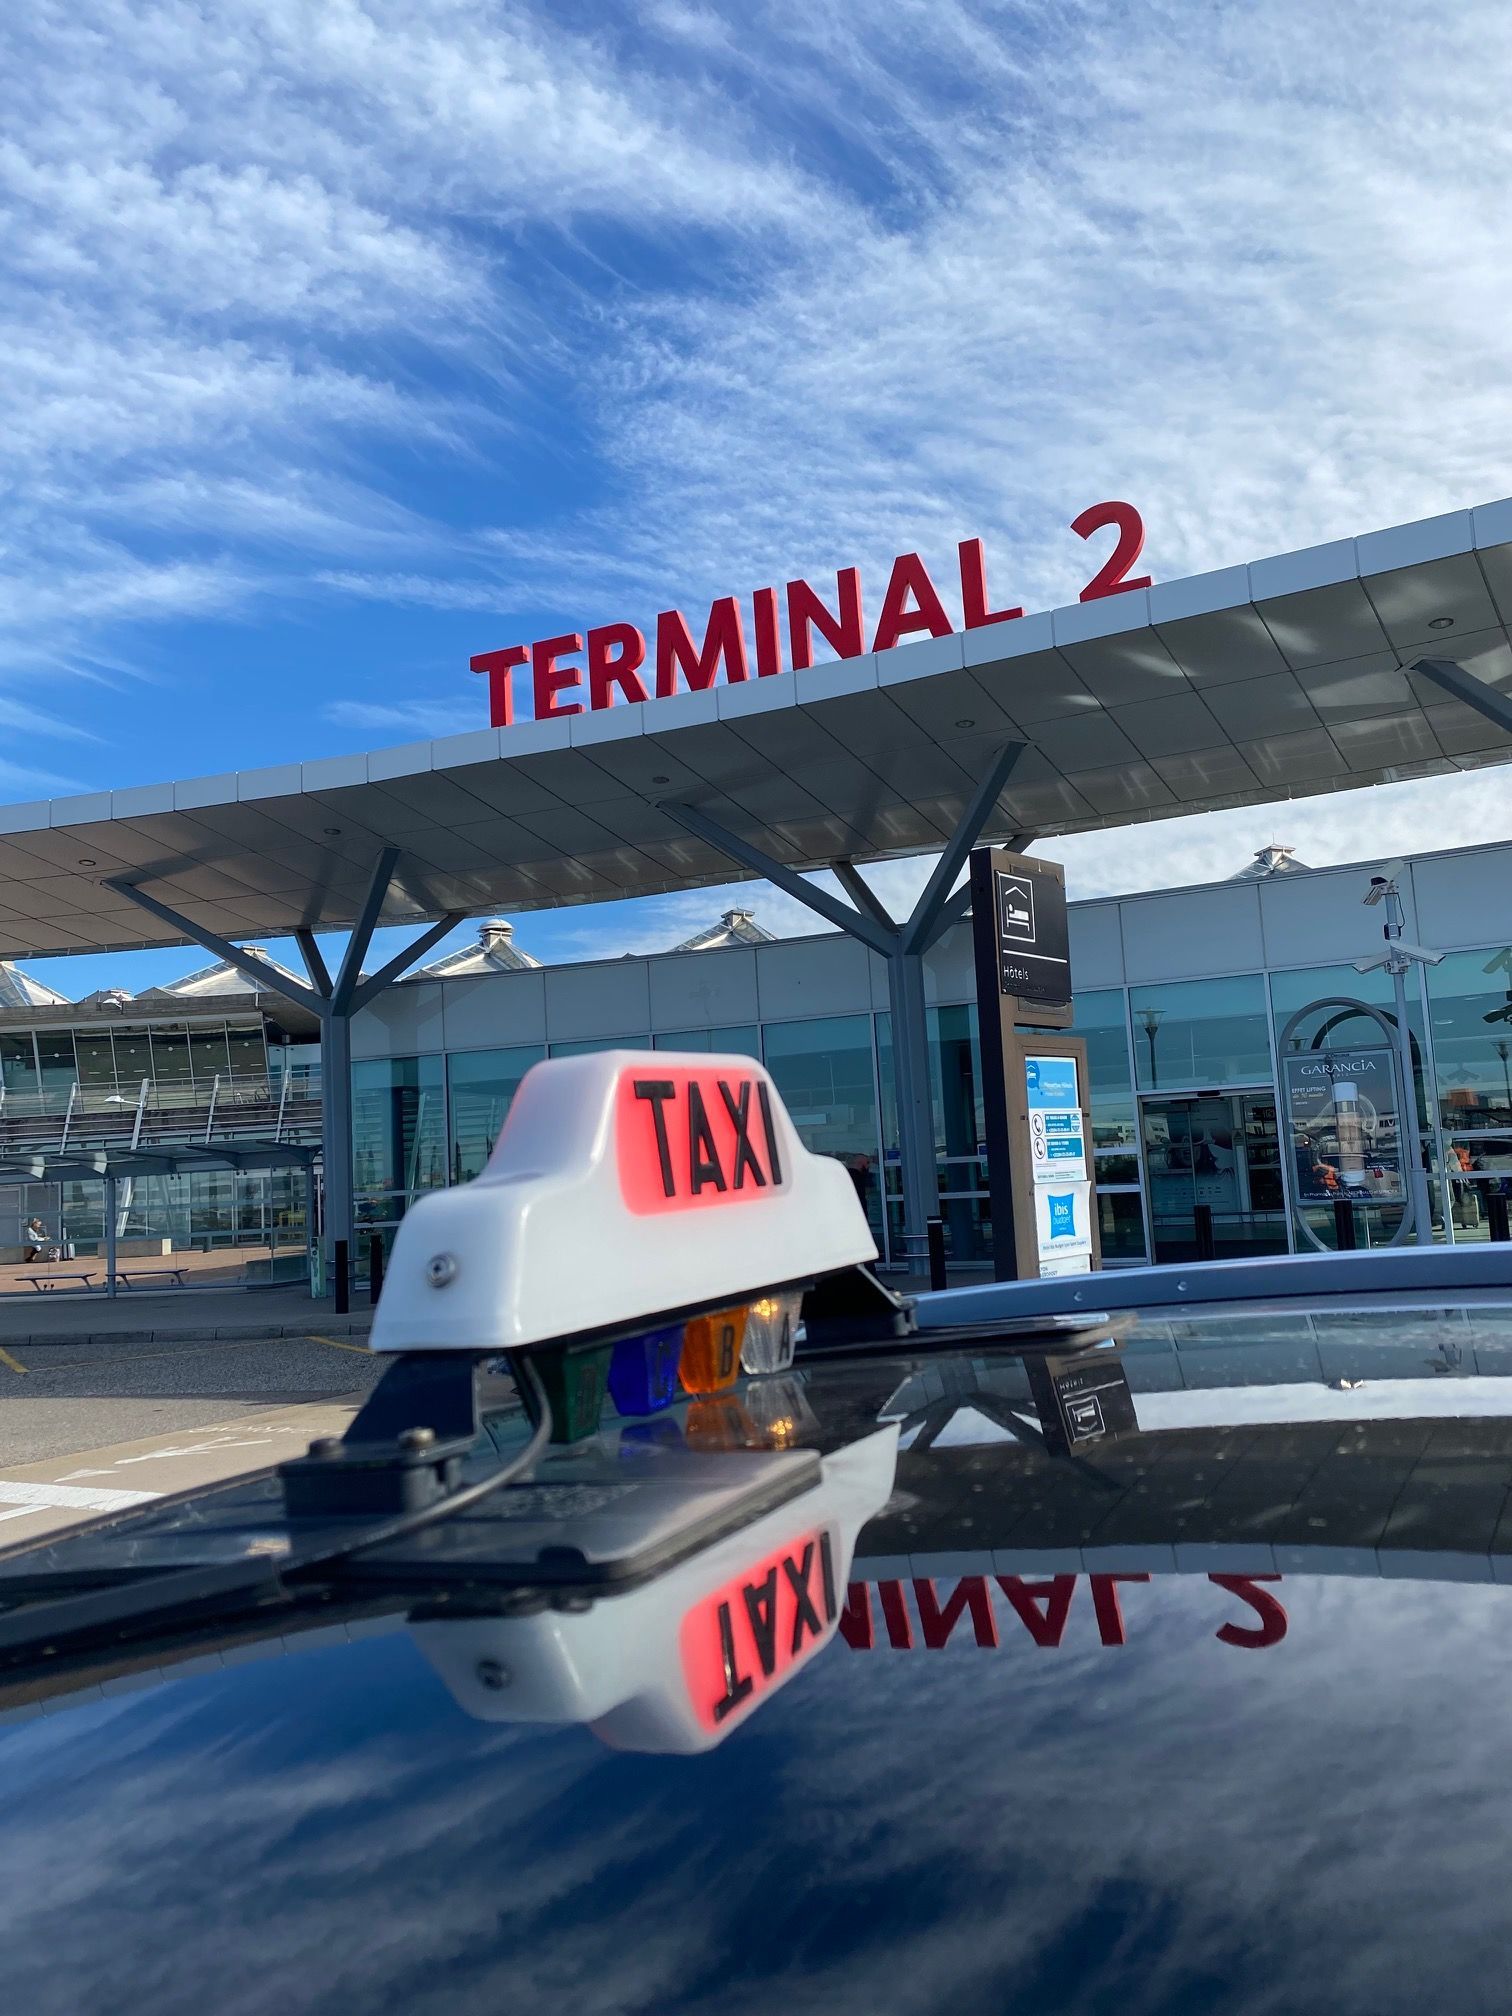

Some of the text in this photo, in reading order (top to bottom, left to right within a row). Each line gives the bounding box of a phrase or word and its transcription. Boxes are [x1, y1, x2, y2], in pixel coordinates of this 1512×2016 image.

[470, 501, 1151, 728] TERMINAL 2
[1003, 965, 1029, 980] Hôtels
[633, 1080, 782, 1197] TAXI
[1054, 1203, 1069, 1216] ibis
[720, 1323, 735, 1379] B
